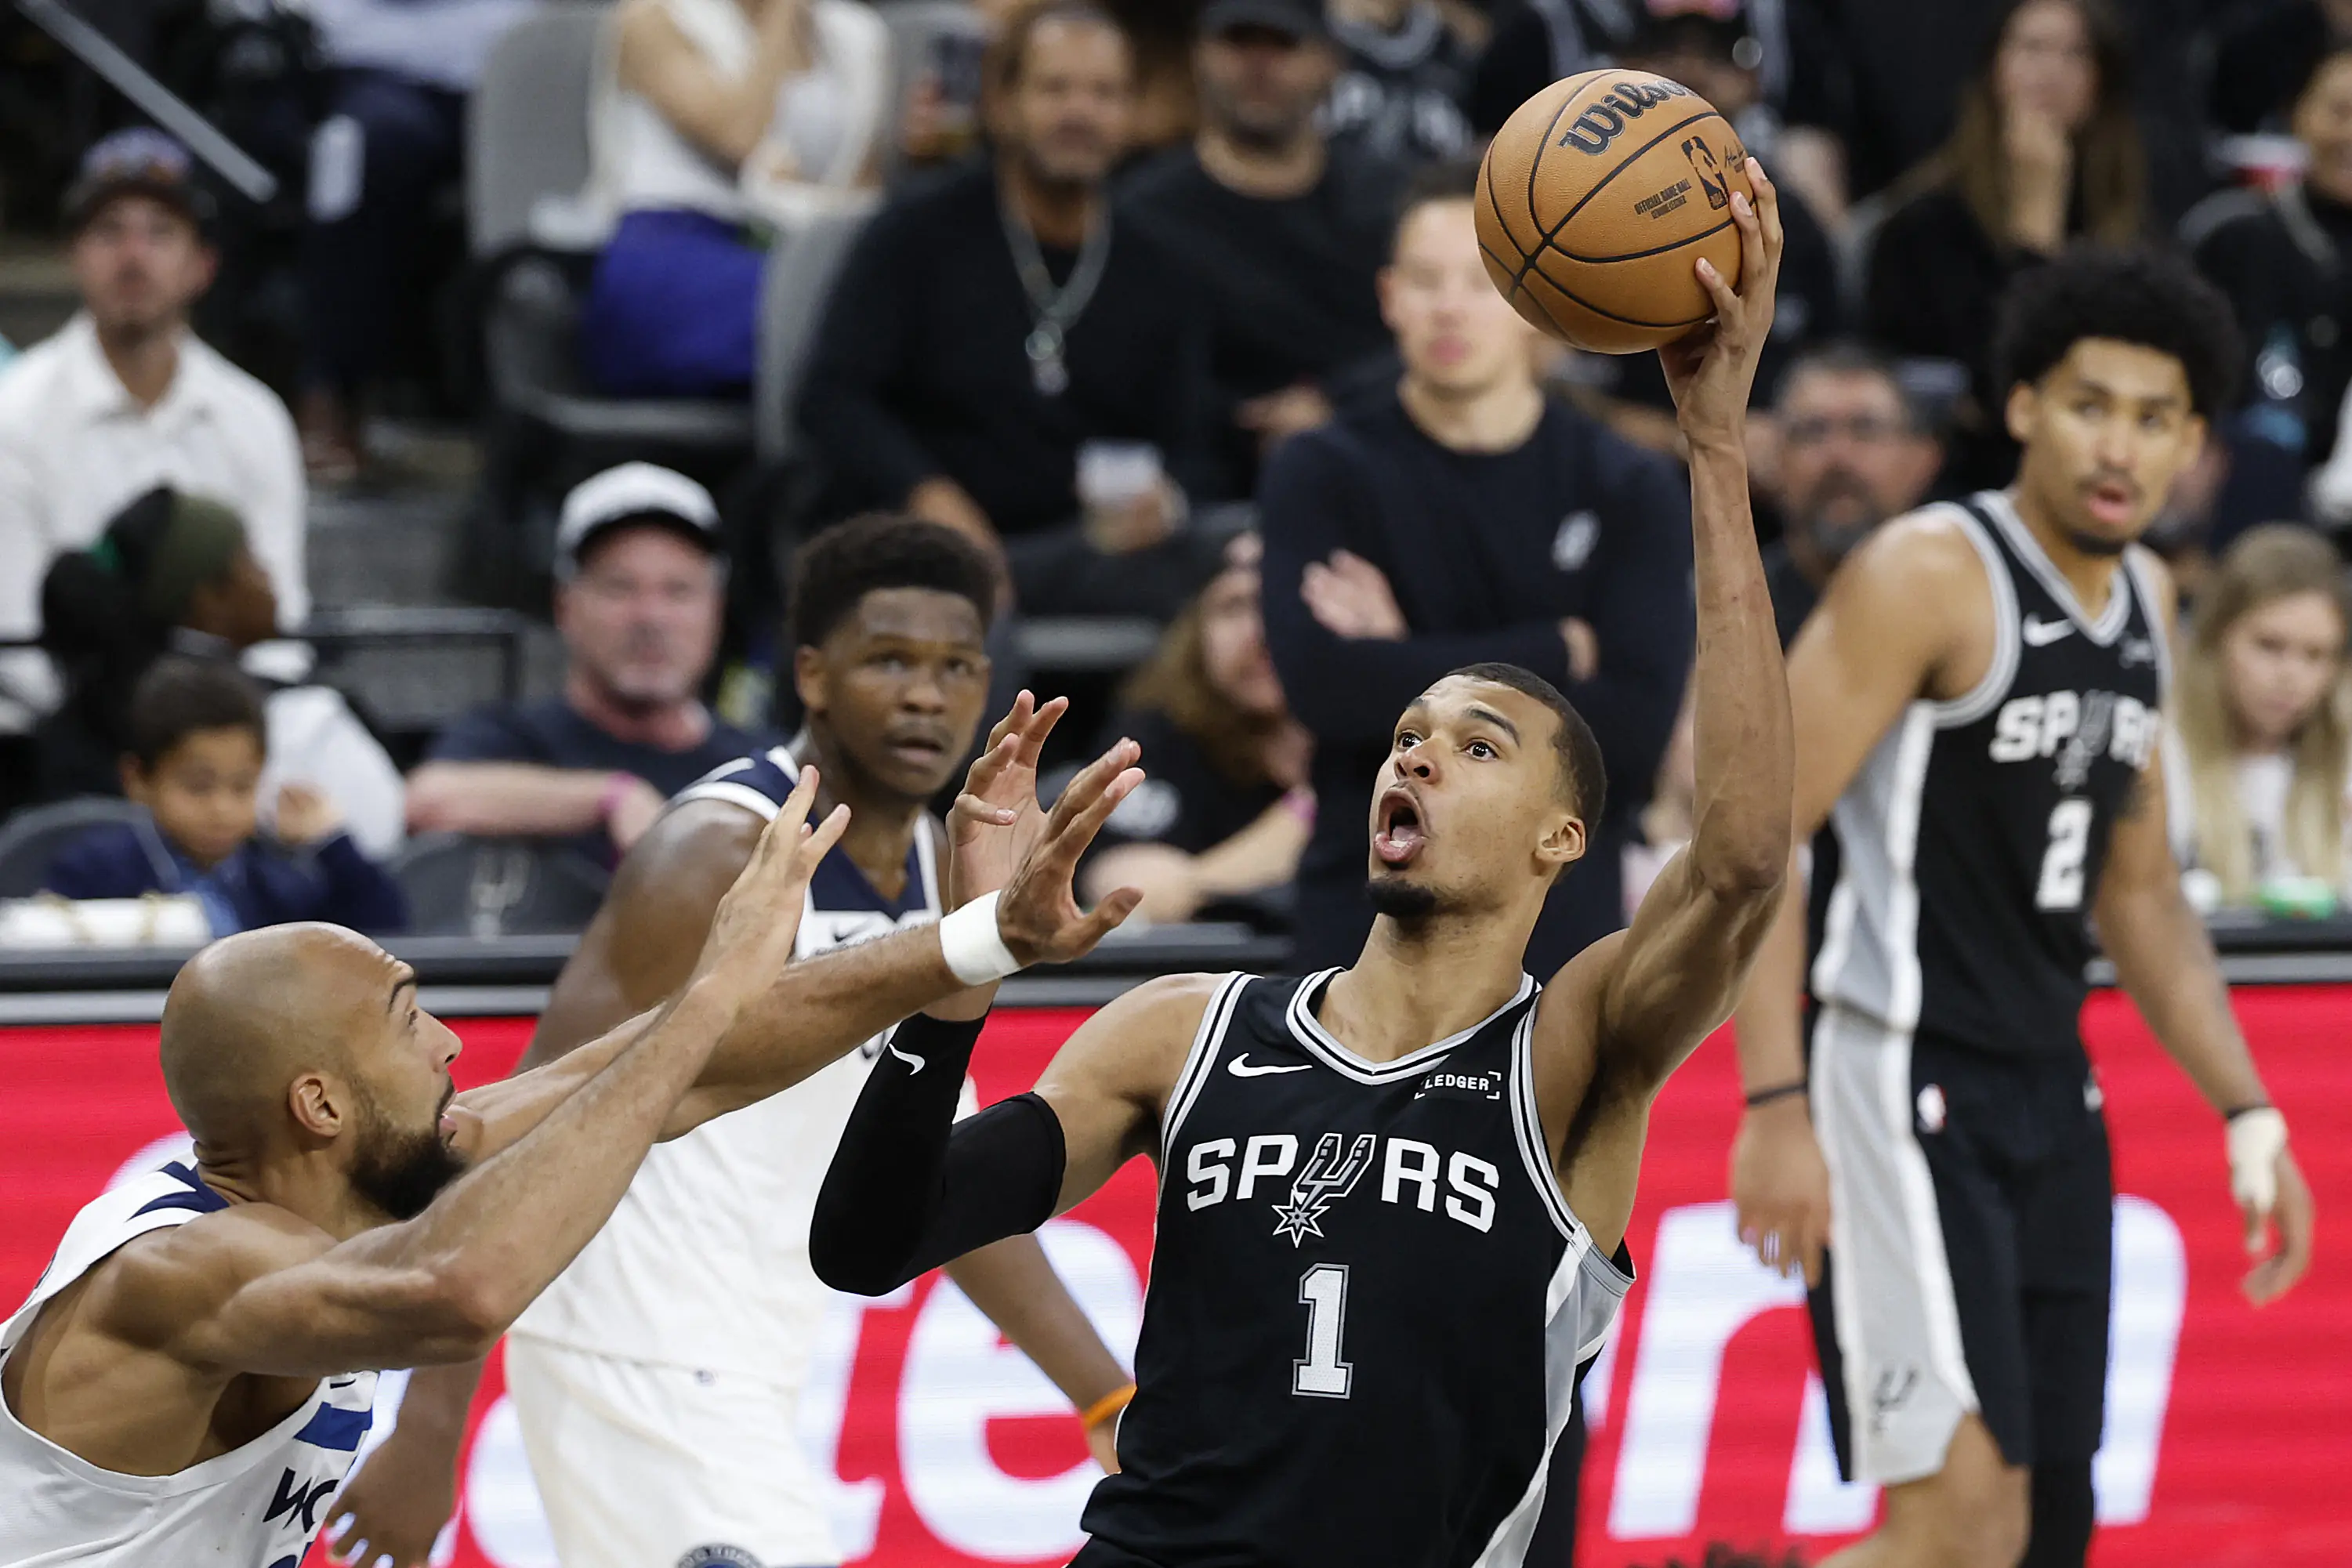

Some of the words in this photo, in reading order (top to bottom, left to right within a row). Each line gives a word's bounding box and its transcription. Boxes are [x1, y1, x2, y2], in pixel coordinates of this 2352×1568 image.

[1557, 81, 1700, 156] Wilso
[1988, 689, 2162, 791] SPUR
[2034, 795, 2094, 912] 2
[1424, 1074, 1490, 1091] LEDGER
[1186, 1132, 1500, 1248] SPURS
[1292, 1262, 1354, 1400] 1
